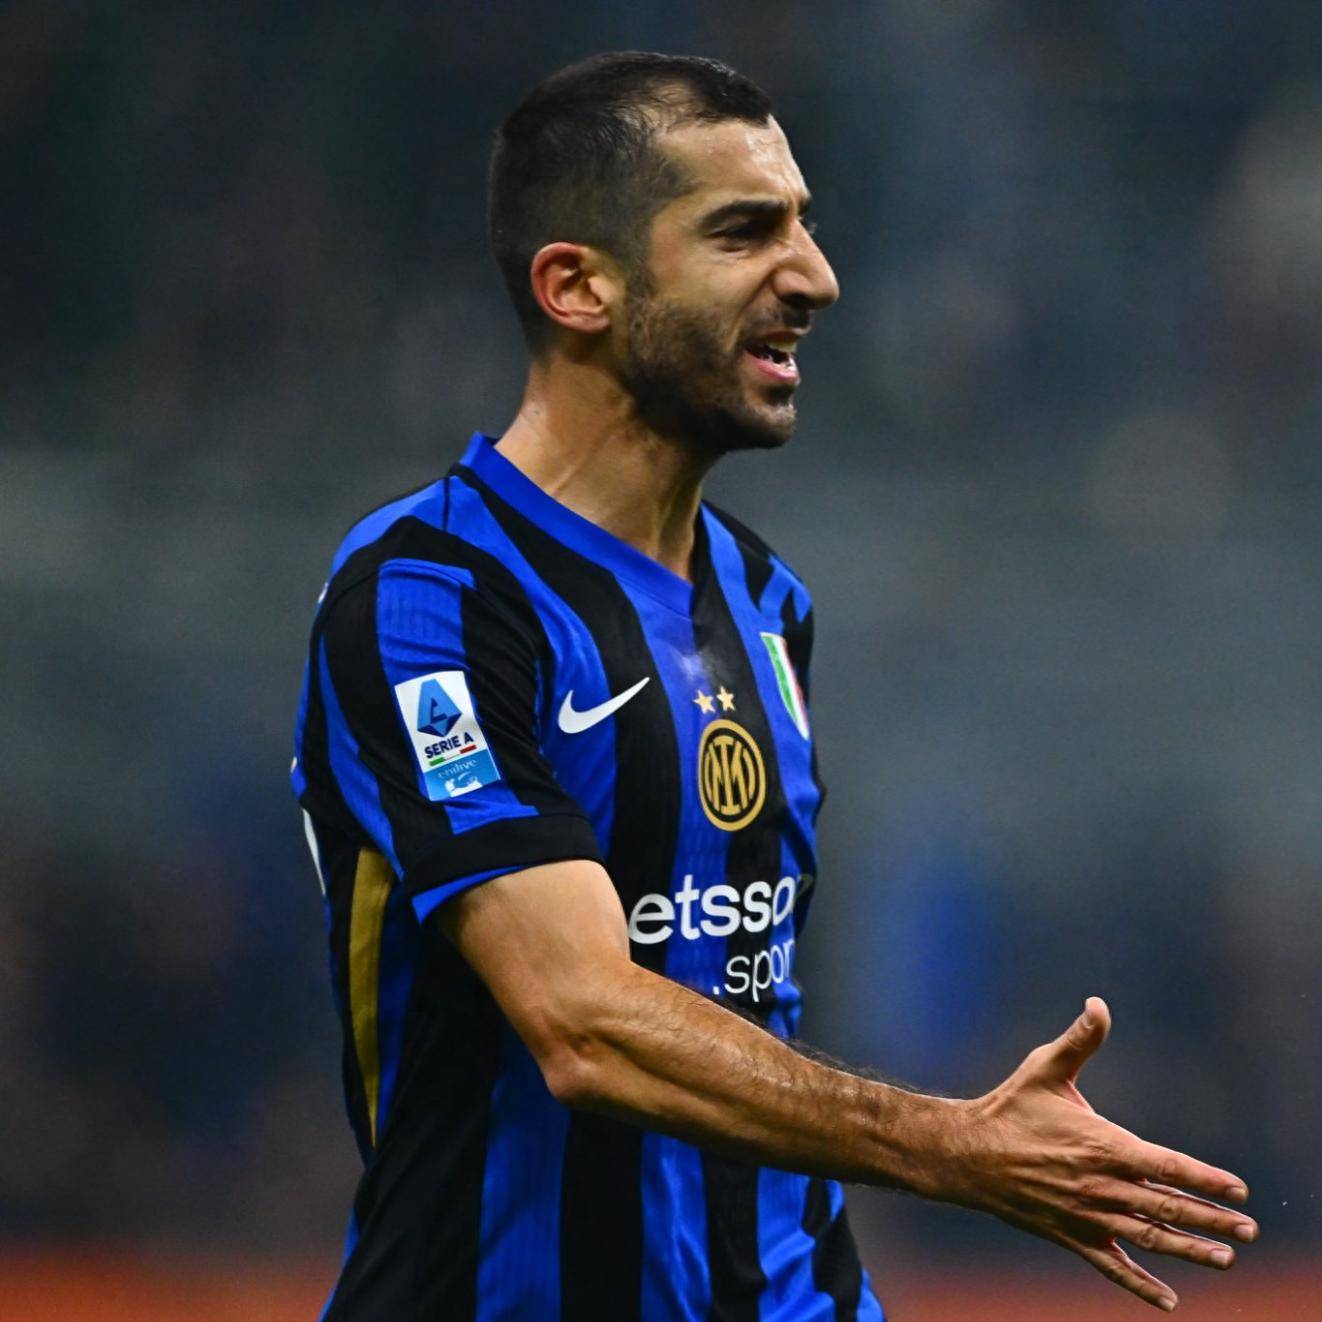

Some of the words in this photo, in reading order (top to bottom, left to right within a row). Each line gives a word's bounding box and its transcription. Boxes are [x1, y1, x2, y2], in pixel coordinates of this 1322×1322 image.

[424, 735, 462, 759] SERIE
[463, 732, 474, 745] A
[628, 874, 815, 945] etsso
[712, 938, 795, 1003] .spor
